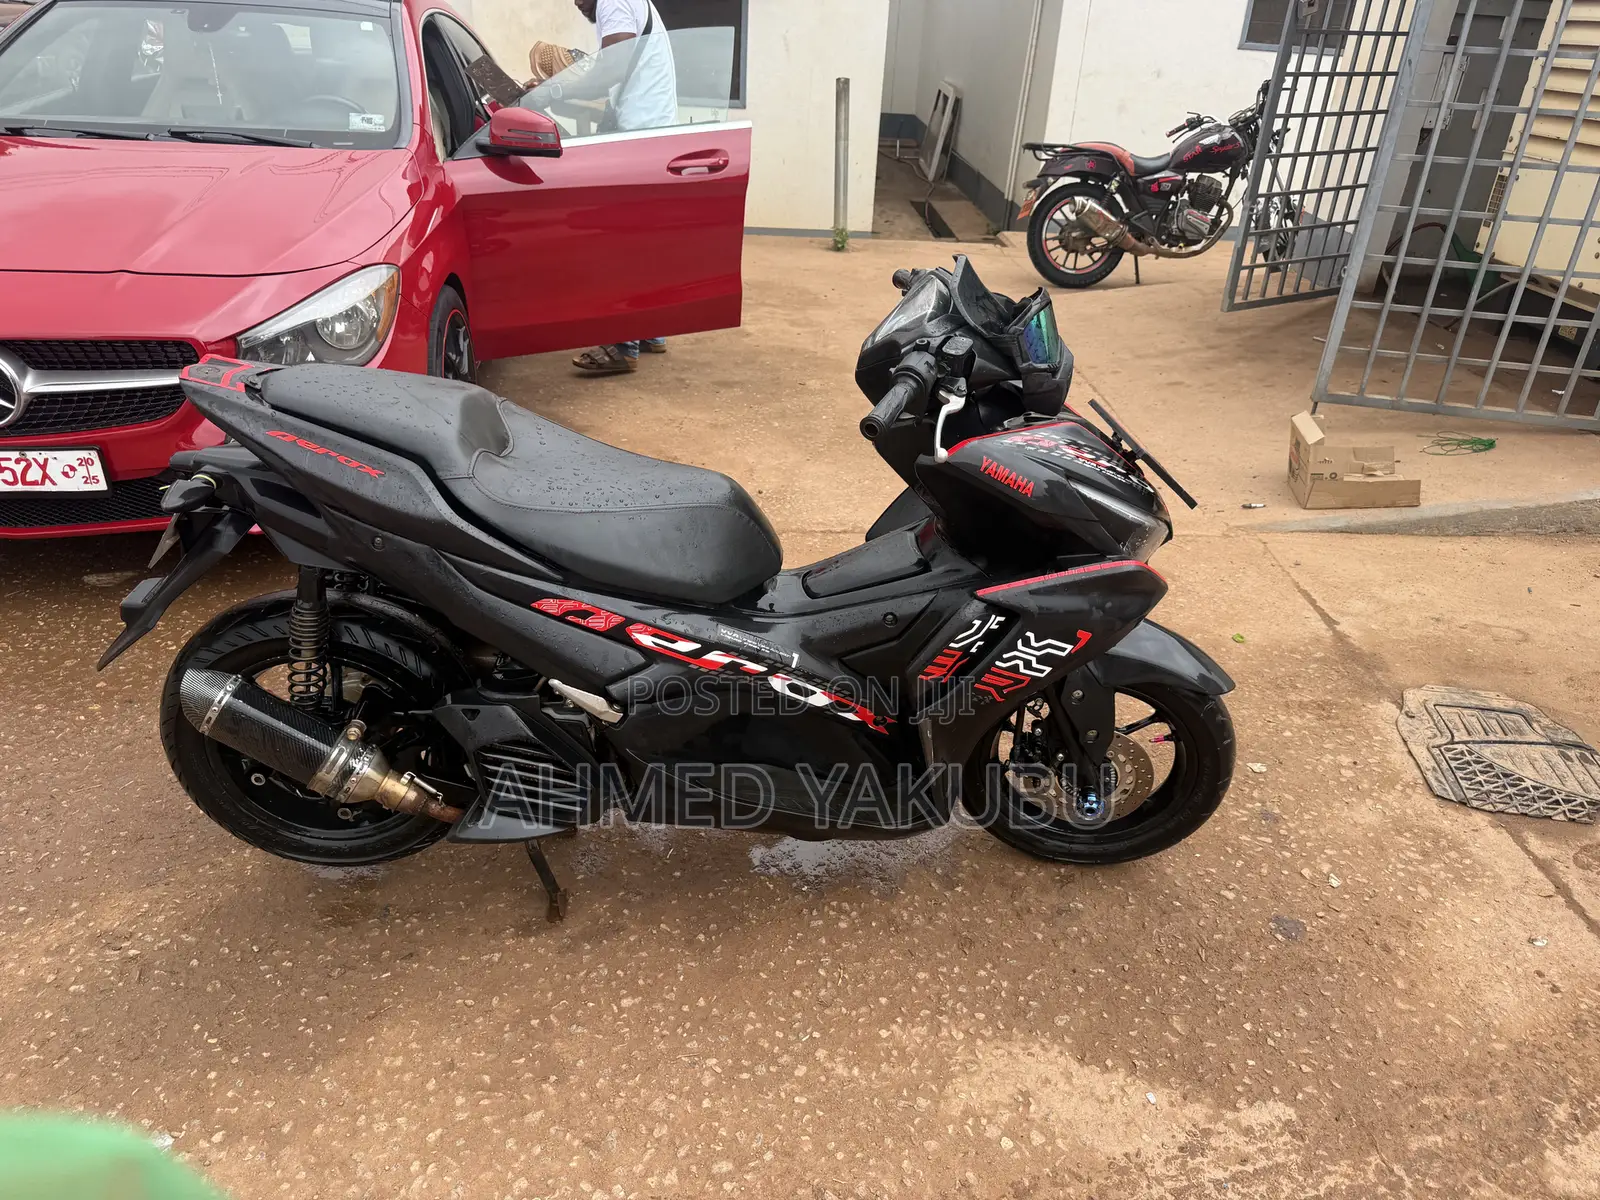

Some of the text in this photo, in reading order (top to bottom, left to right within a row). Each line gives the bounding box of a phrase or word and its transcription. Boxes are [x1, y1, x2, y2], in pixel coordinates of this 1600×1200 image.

[76, 456, 95, 467] 20
[81, 474, 100, 485] 25
[979, 455, 1035, 498] YAMAHA
